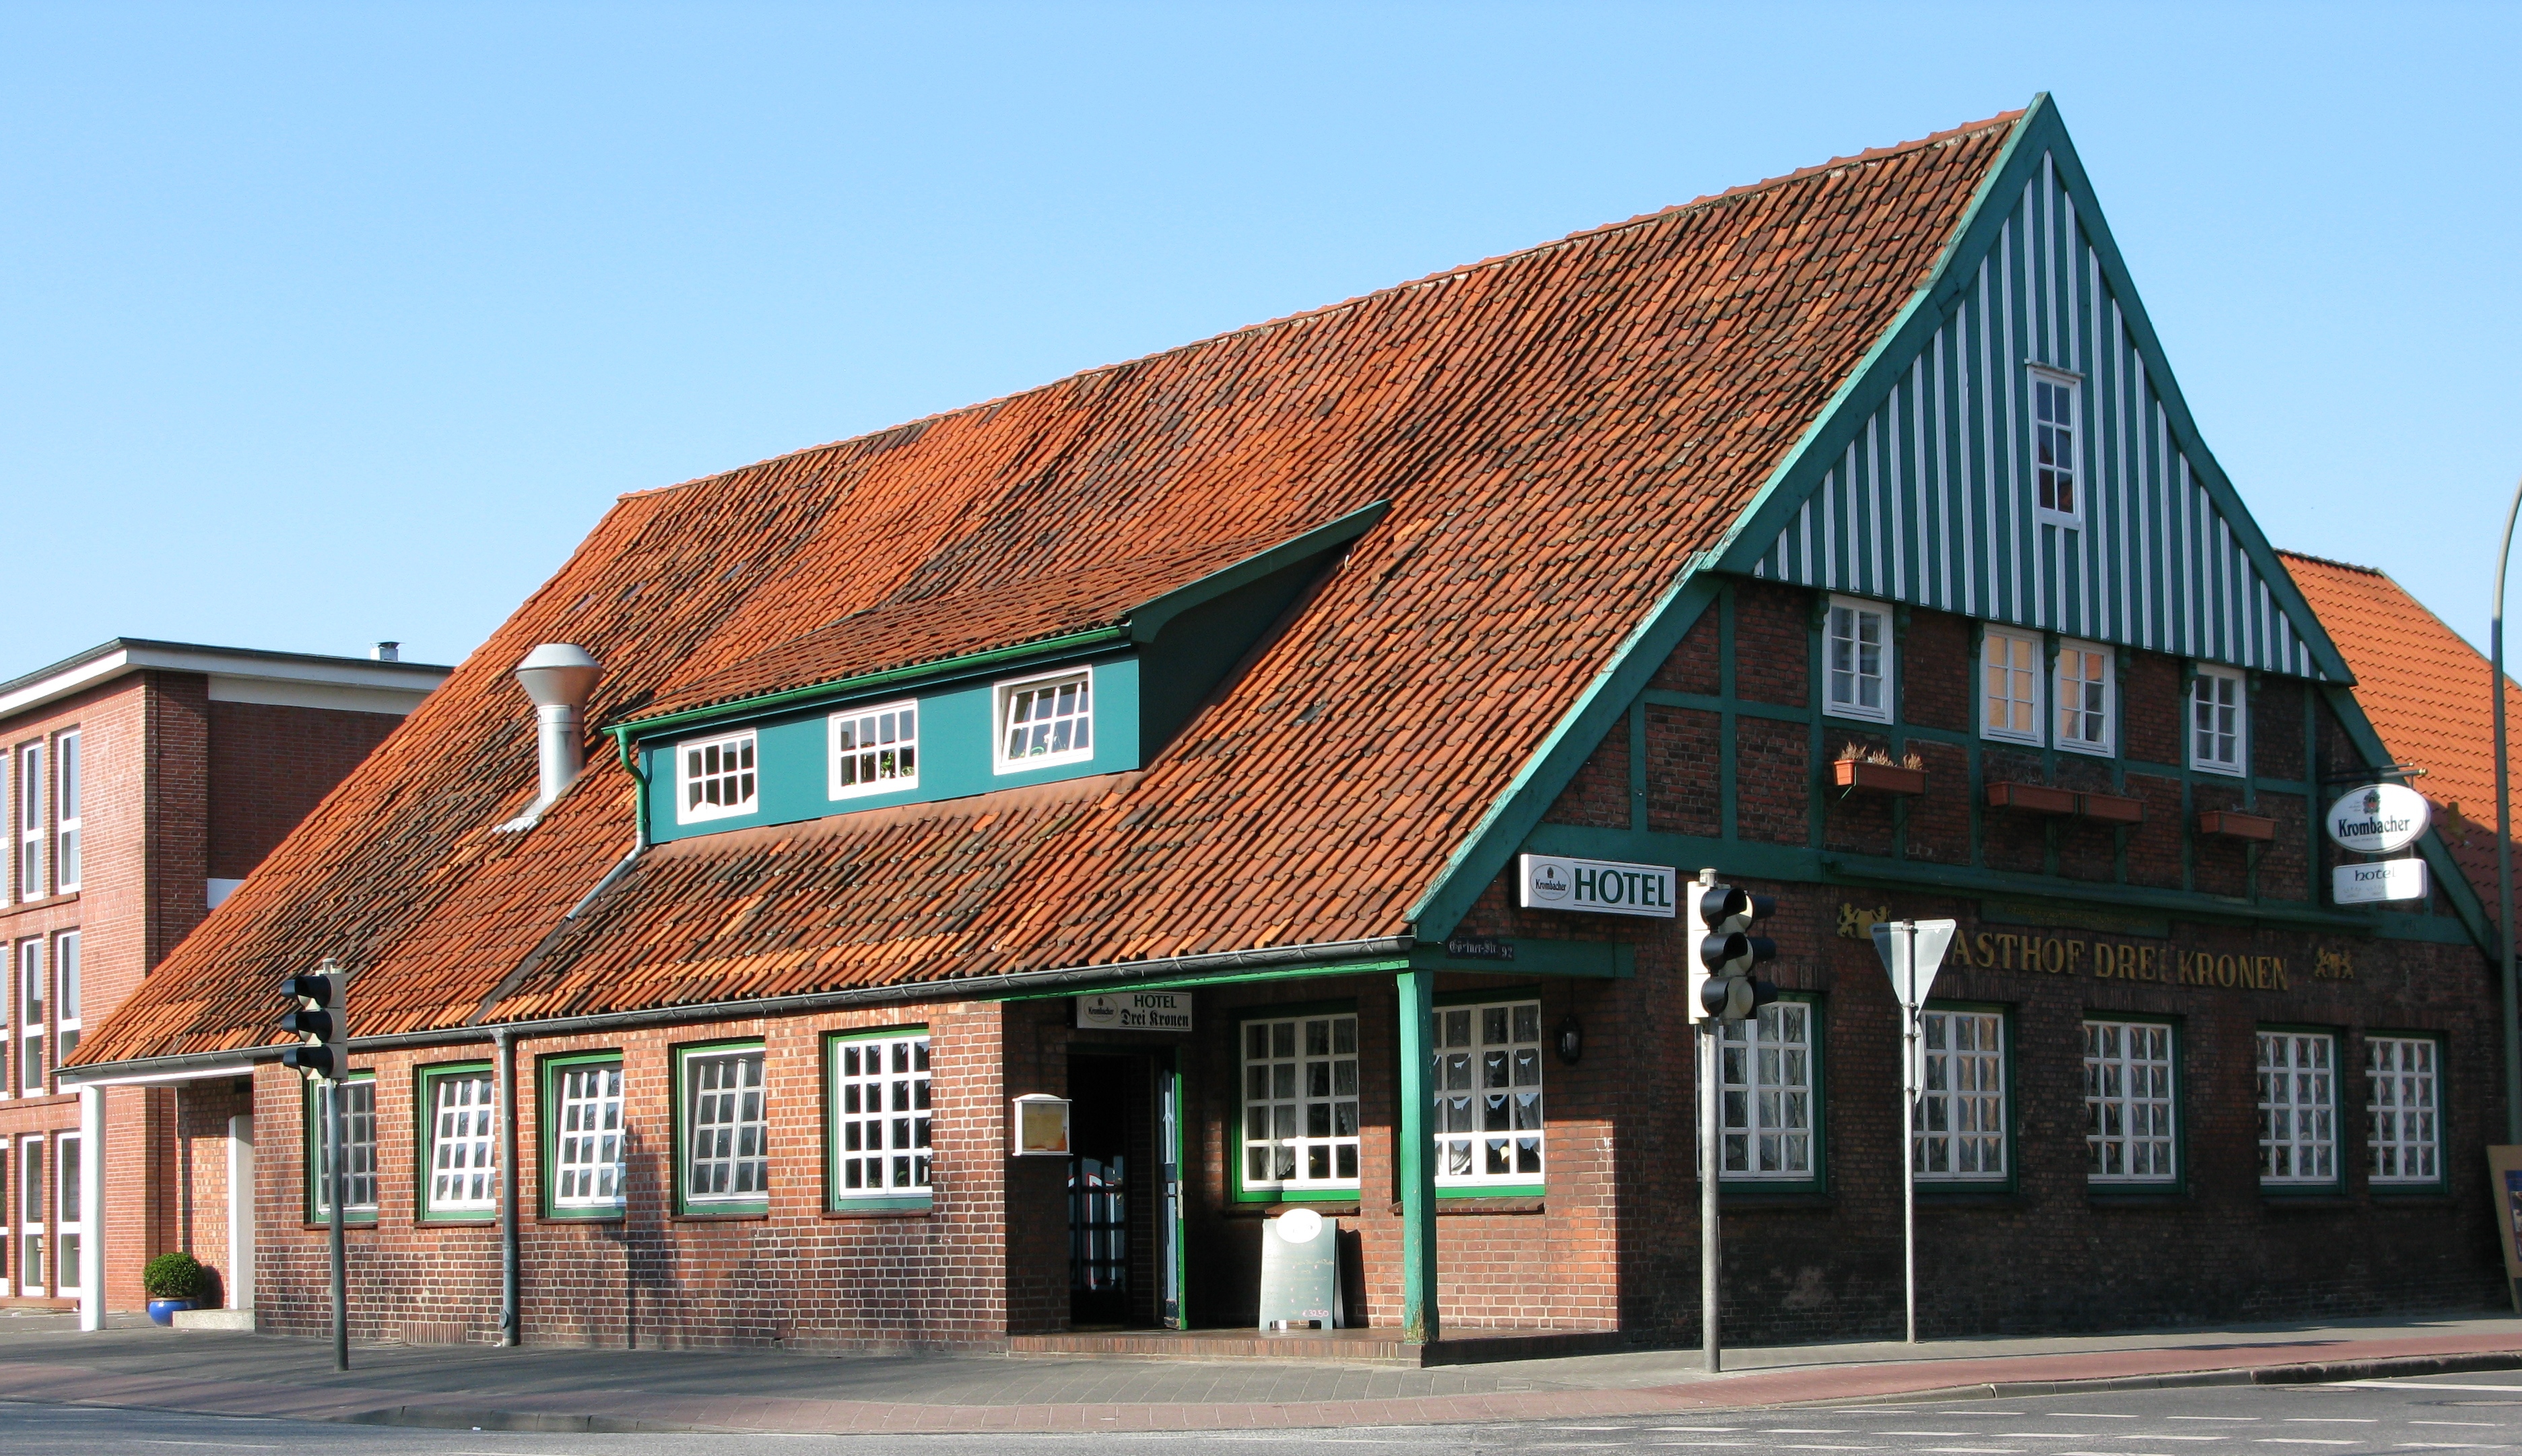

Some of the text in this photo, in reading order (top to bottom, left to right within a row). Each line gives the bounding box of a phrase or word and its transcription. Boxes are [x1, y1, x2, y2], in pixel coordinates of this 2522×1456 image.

[2338, 815, 2410, 838] Krombacher
[2354, 866, 2397, 882] hotel
[1535, 878, 1566, 892] Krombacher
[1574, 867, 1671, 907] HOTEL
[1502, 946, 1513, 958] 92
[1950, 928, 2289, 991] ASTHOF DREI KRONEN
[1134, 994, 1177, 1009] HOTEL
[1120, 1008, 1189, 1027] Drei Kronen
